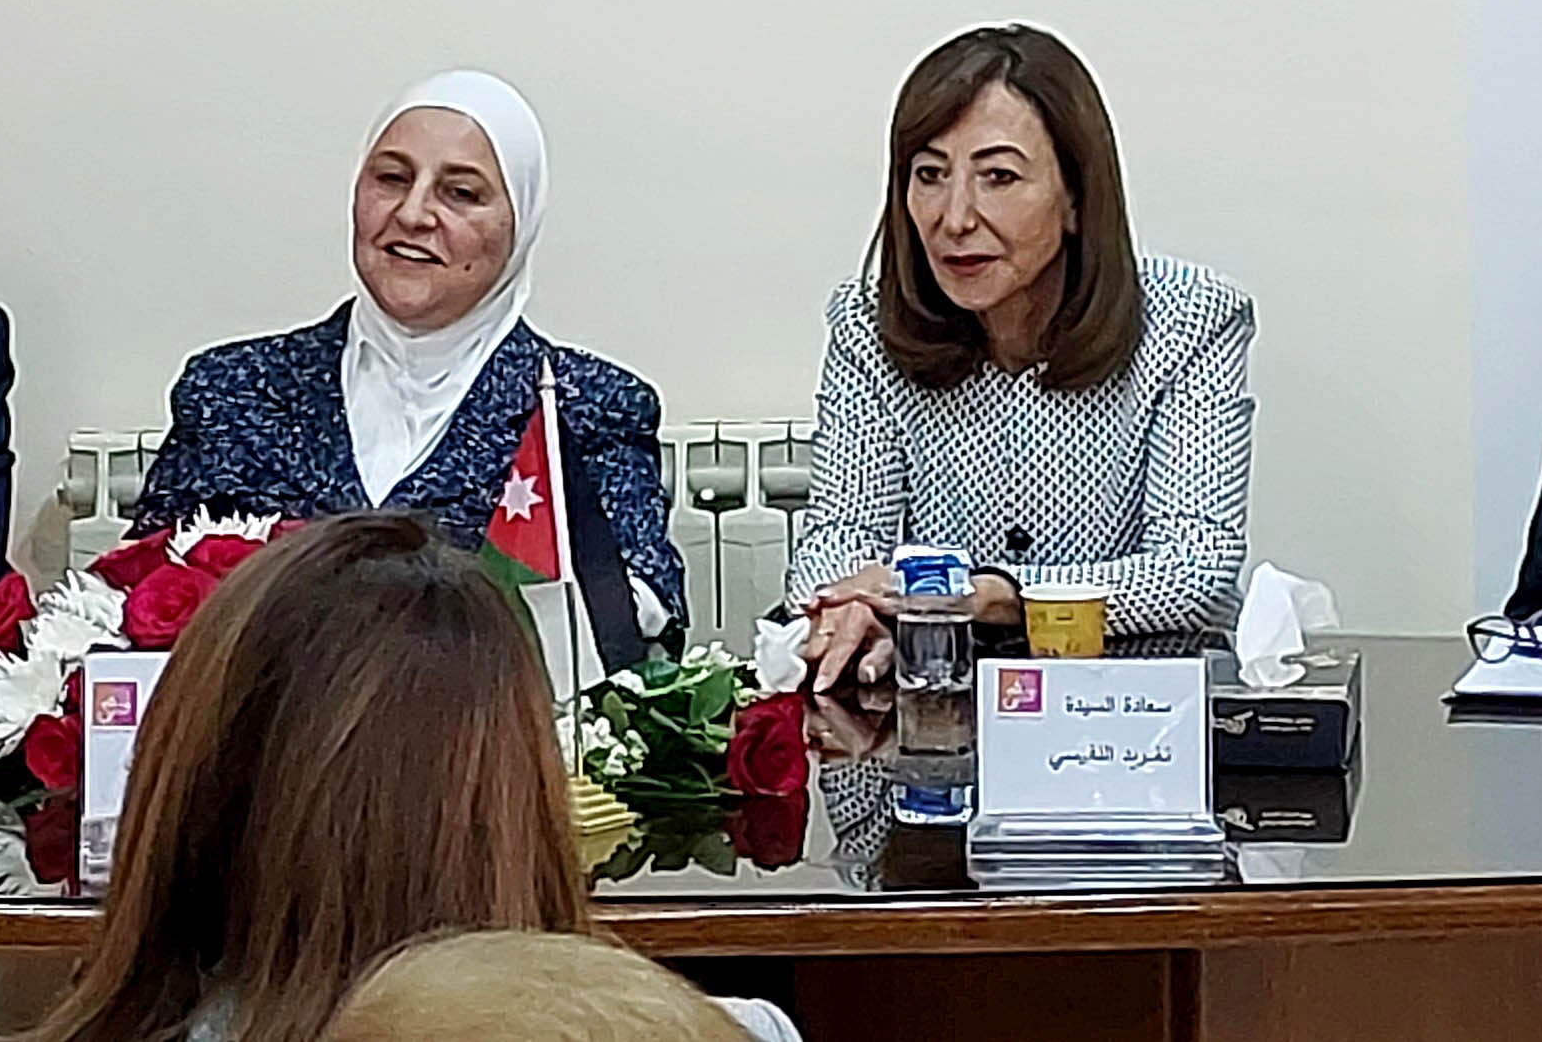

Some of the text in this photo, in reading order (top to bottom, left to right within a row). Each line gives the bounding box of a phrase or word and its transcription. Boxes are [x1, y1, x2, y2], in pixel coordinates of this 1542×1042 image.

[1065, 695, 1172, 717] سعادة السيدة
[1122, 744, 1172, 770] تغريد
